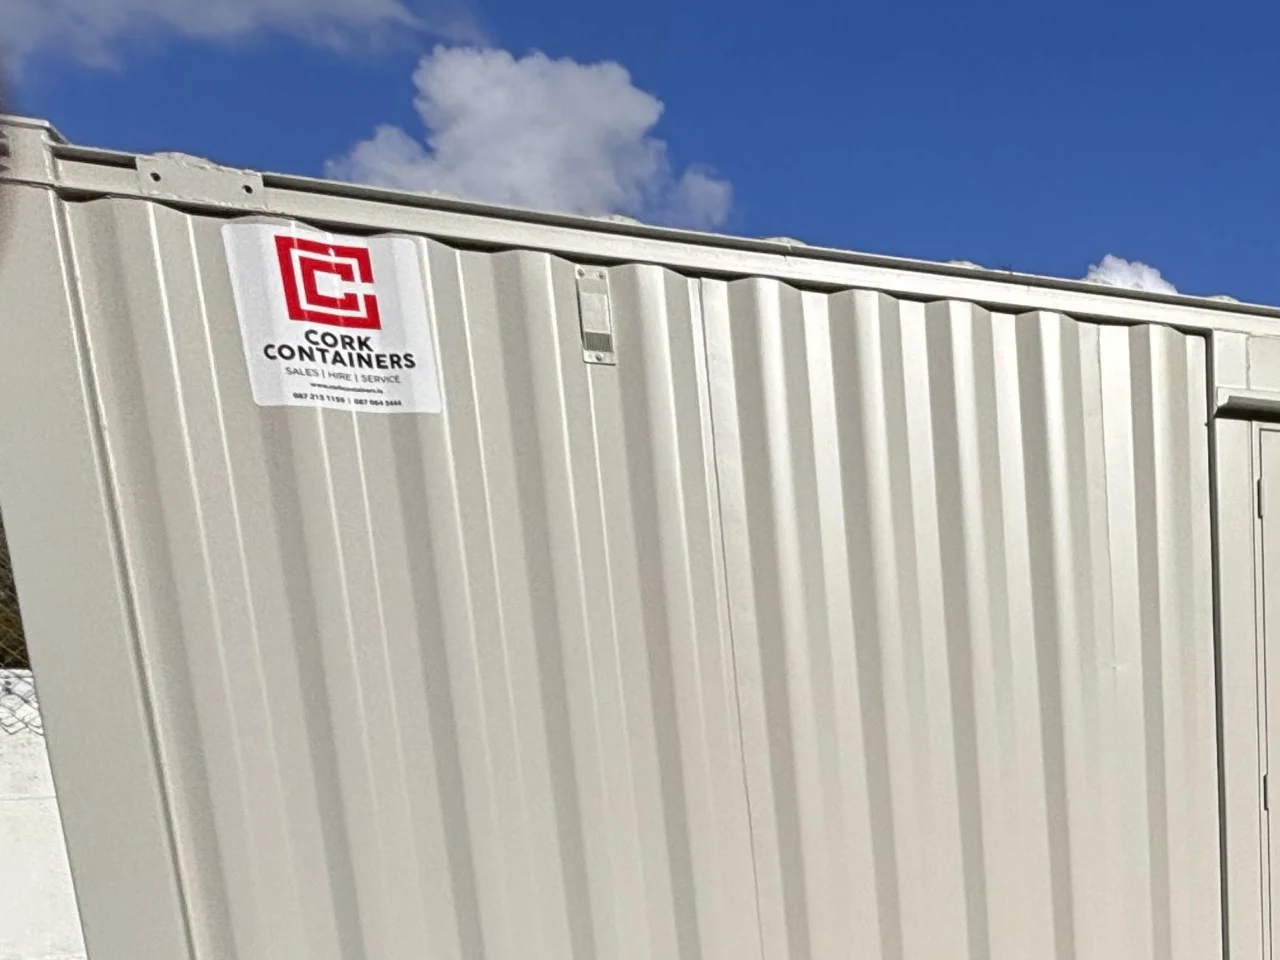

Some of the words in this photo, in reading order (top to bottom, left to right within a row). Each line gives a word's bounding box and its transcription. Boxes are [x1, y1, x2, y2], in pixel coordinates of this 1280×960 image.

[304, 329, 374, 352] CORK
[263, 343, 417, 370] CONTAINERS
[285, 366, 319, 378] SALES
[328, 370, 352, 382] HIRE
[361, 374, 402, 384] SERVICE
